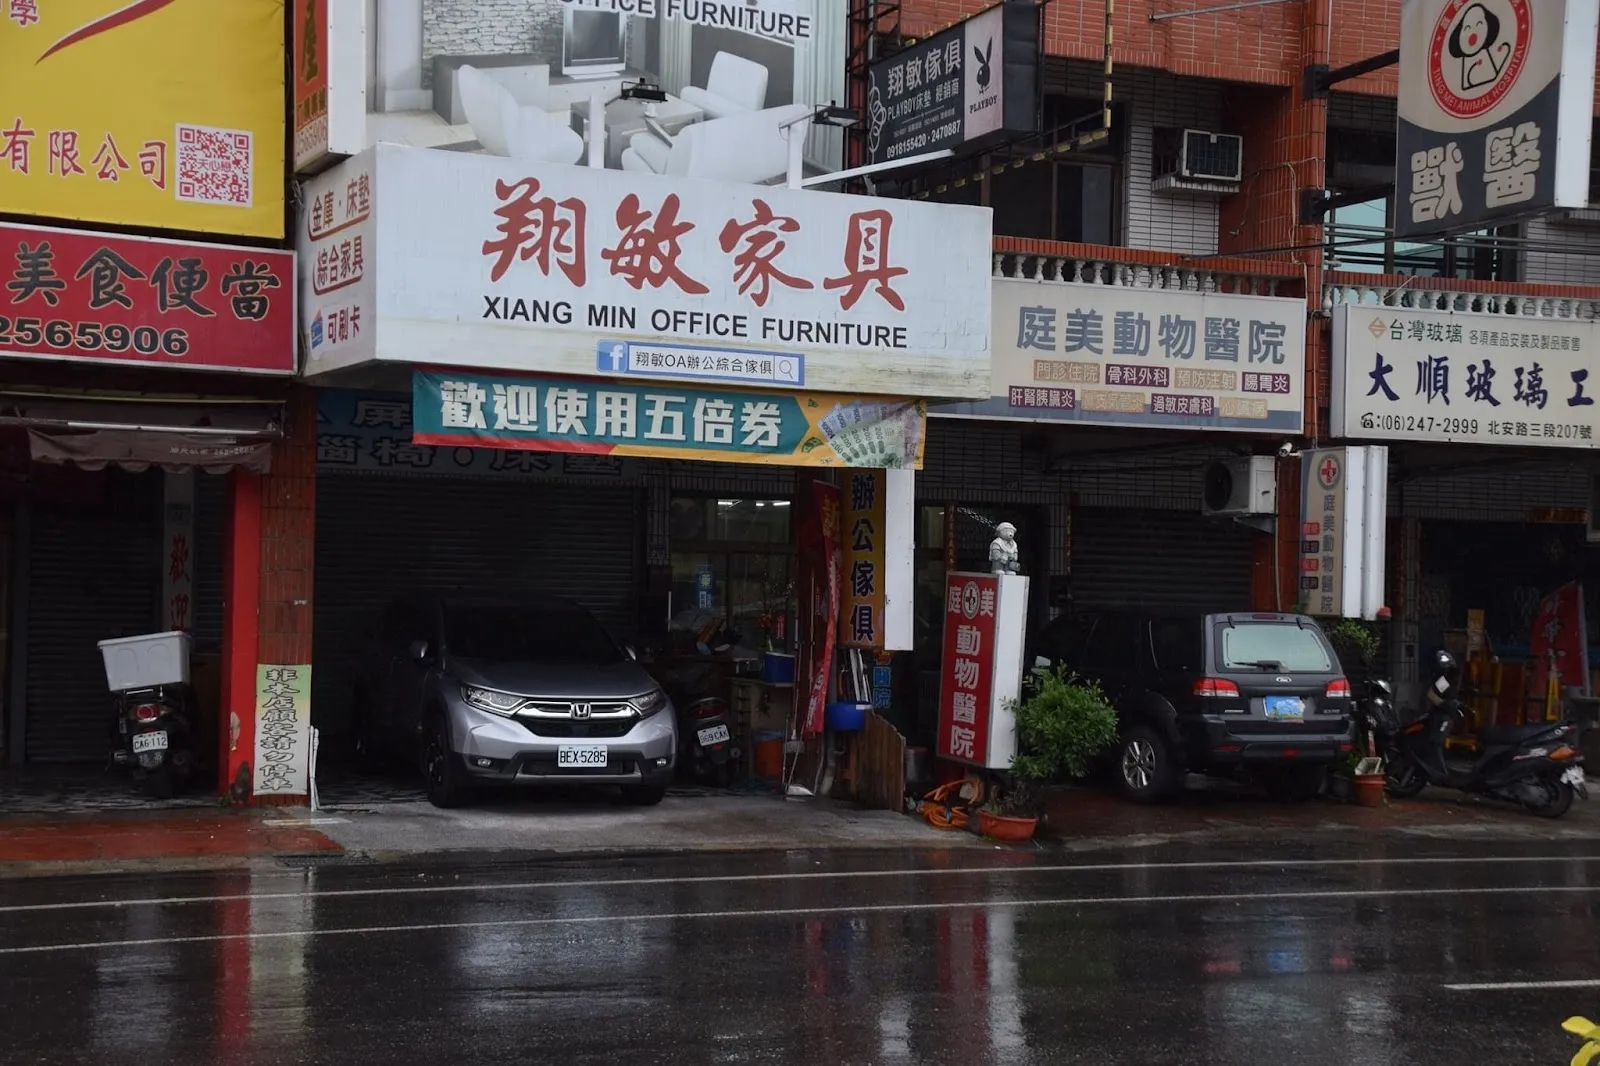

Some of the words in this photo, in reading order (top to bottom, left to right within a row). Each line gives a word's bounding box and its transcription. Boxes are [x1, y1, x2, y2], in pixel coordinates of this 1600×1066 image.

[667, 0, 811, 37] FURNITURE
[887, 38, 962, 99] 翔敏傢俱
[1458, 96, 1495, 112] ANIMAL
[1491, 44, 1524, 98] HOSPITAL
[969, 95, 998, 114] PLAYBOY
[0, 117, 168, 191] 有限公司
[1409, 121, 1542, 224] 獸醫
[316, 235, 364, 287] 綜合家具
[482, 176, 909, 311] 翔敏家具
[5, 240, 282, 322] 美食便當
[327, 305, 361, 344] 可刷卡
[482, 295, 574, 325] XIANG
[588, 303, 636, 330] MIN
[651, 308, 748, 338] OFFICE
[762, 317, 909, 349] FURNITURE
[1016, 304, 1287, 365] 庭美動物醫院
[1389, 319, 1463, 344] 台灣玻璃
[635, 350, 773, 376] 翔敏OA辦公綜合傢俱
[1035, 361, 1099, 383] 門診住院
[1107, 365, 1169, 387] 骨科外科
[1176, 369, 1236, 391] 預防注射
[1365, 352, 1595, 411] 大順玻璃工
[1243, 373, 1289, 393] 腸胃炎
[439, 381, 783, 447] 歡迎使用五倍券
[1152, 394, 1213, 416] 過敏皮膚科
[831, 440, 844, 454] 200
[840, 433, 852, 448] 200
[851, 428, 862, 444] 200
[863, 426, 872, 441] 200
[875, 426, 883, 440] 200
[1487, 420, 1593, 440] 北安路三段207號
[851, 472, 876, 643] 辦公傢俱
[949, 624, 982, 759] 動物醫院
[259, 669, 300, 791] 非本店顧客請勿停車
